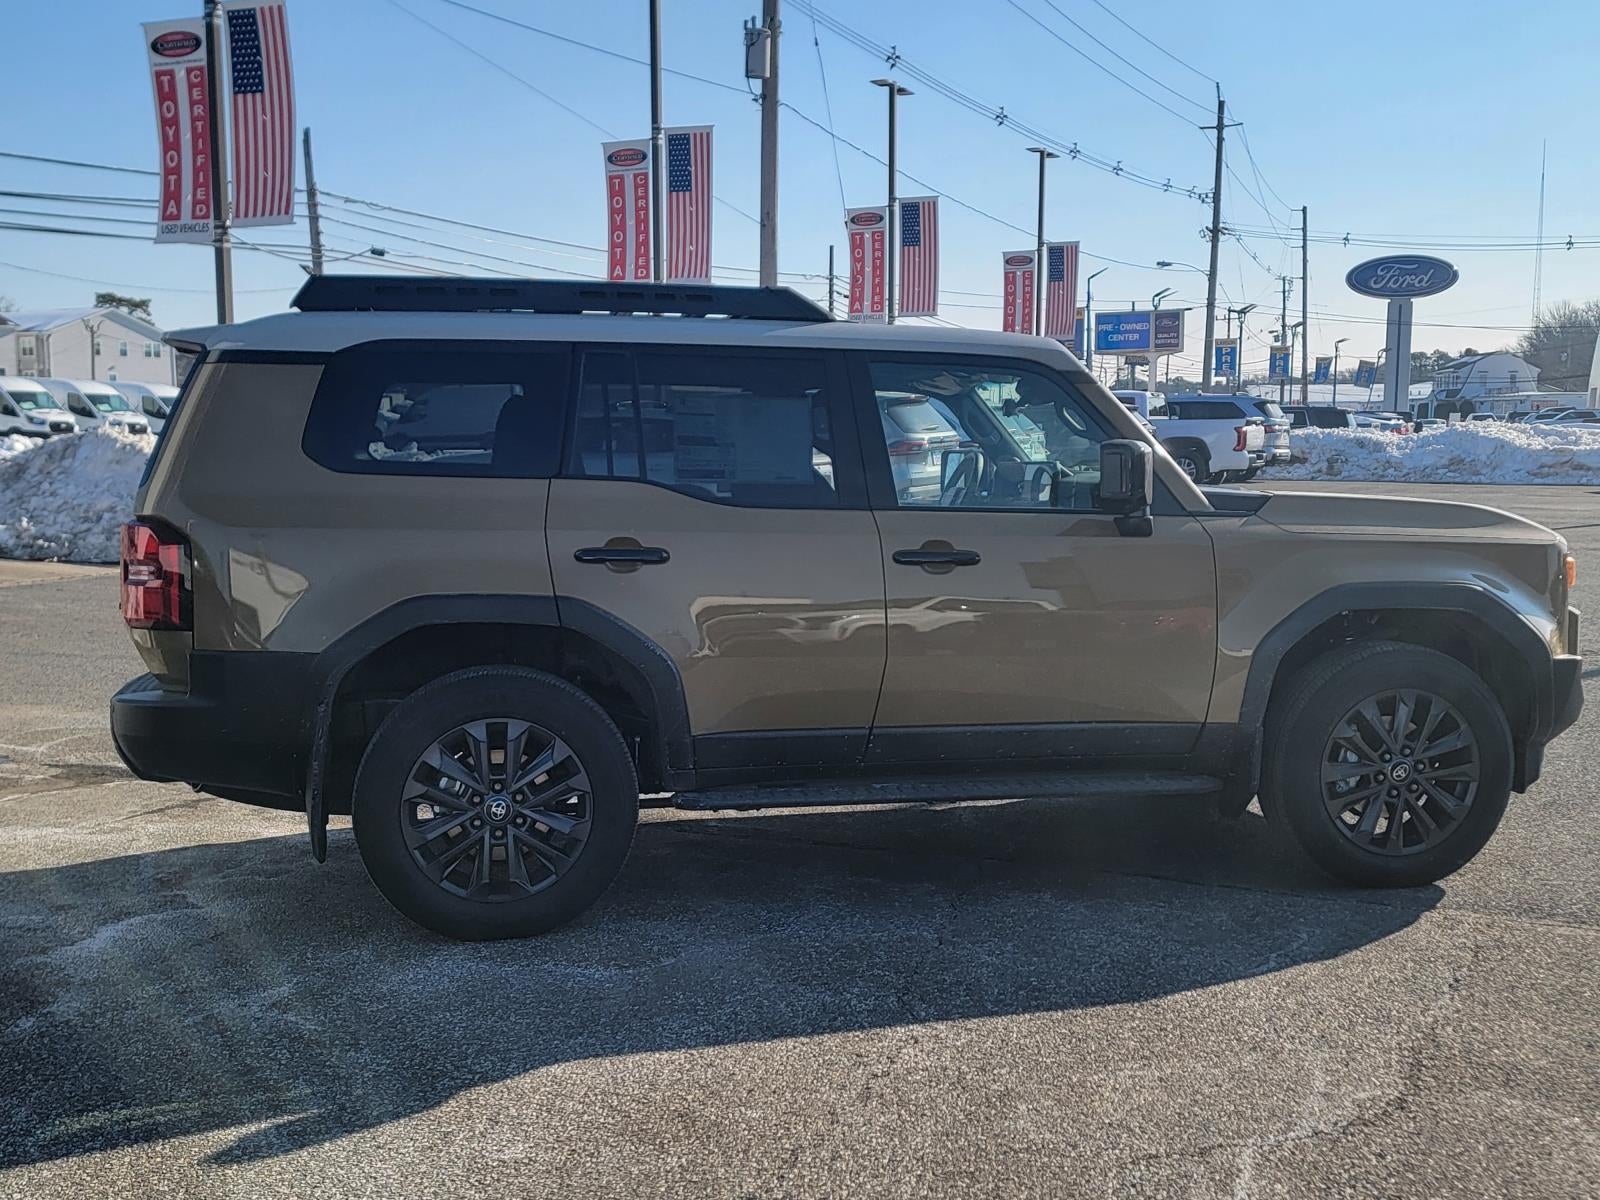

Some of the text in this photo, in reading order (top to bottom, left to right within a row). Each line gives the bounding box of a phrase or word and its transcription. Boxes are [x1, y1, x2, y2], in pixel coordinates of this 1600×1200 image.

[160, 75, 179, 216] TOYOTA
[190, 70, 208, 217] CERTIFIED
[161, 222, 210, 234] USED VEHICLES
[612, 178, 624, 277] TOYOTA
[636, 175, 647, 277] CERTIFIED
[854, 235, 863, 311] TOYOTA
[874, 232, 882, 311] CERTIFIED
[1370, 263, 1434, 289] Ford
[1108, 333, 1140, 342] CENTER
[1222, 347, 1231, 370] PRE
